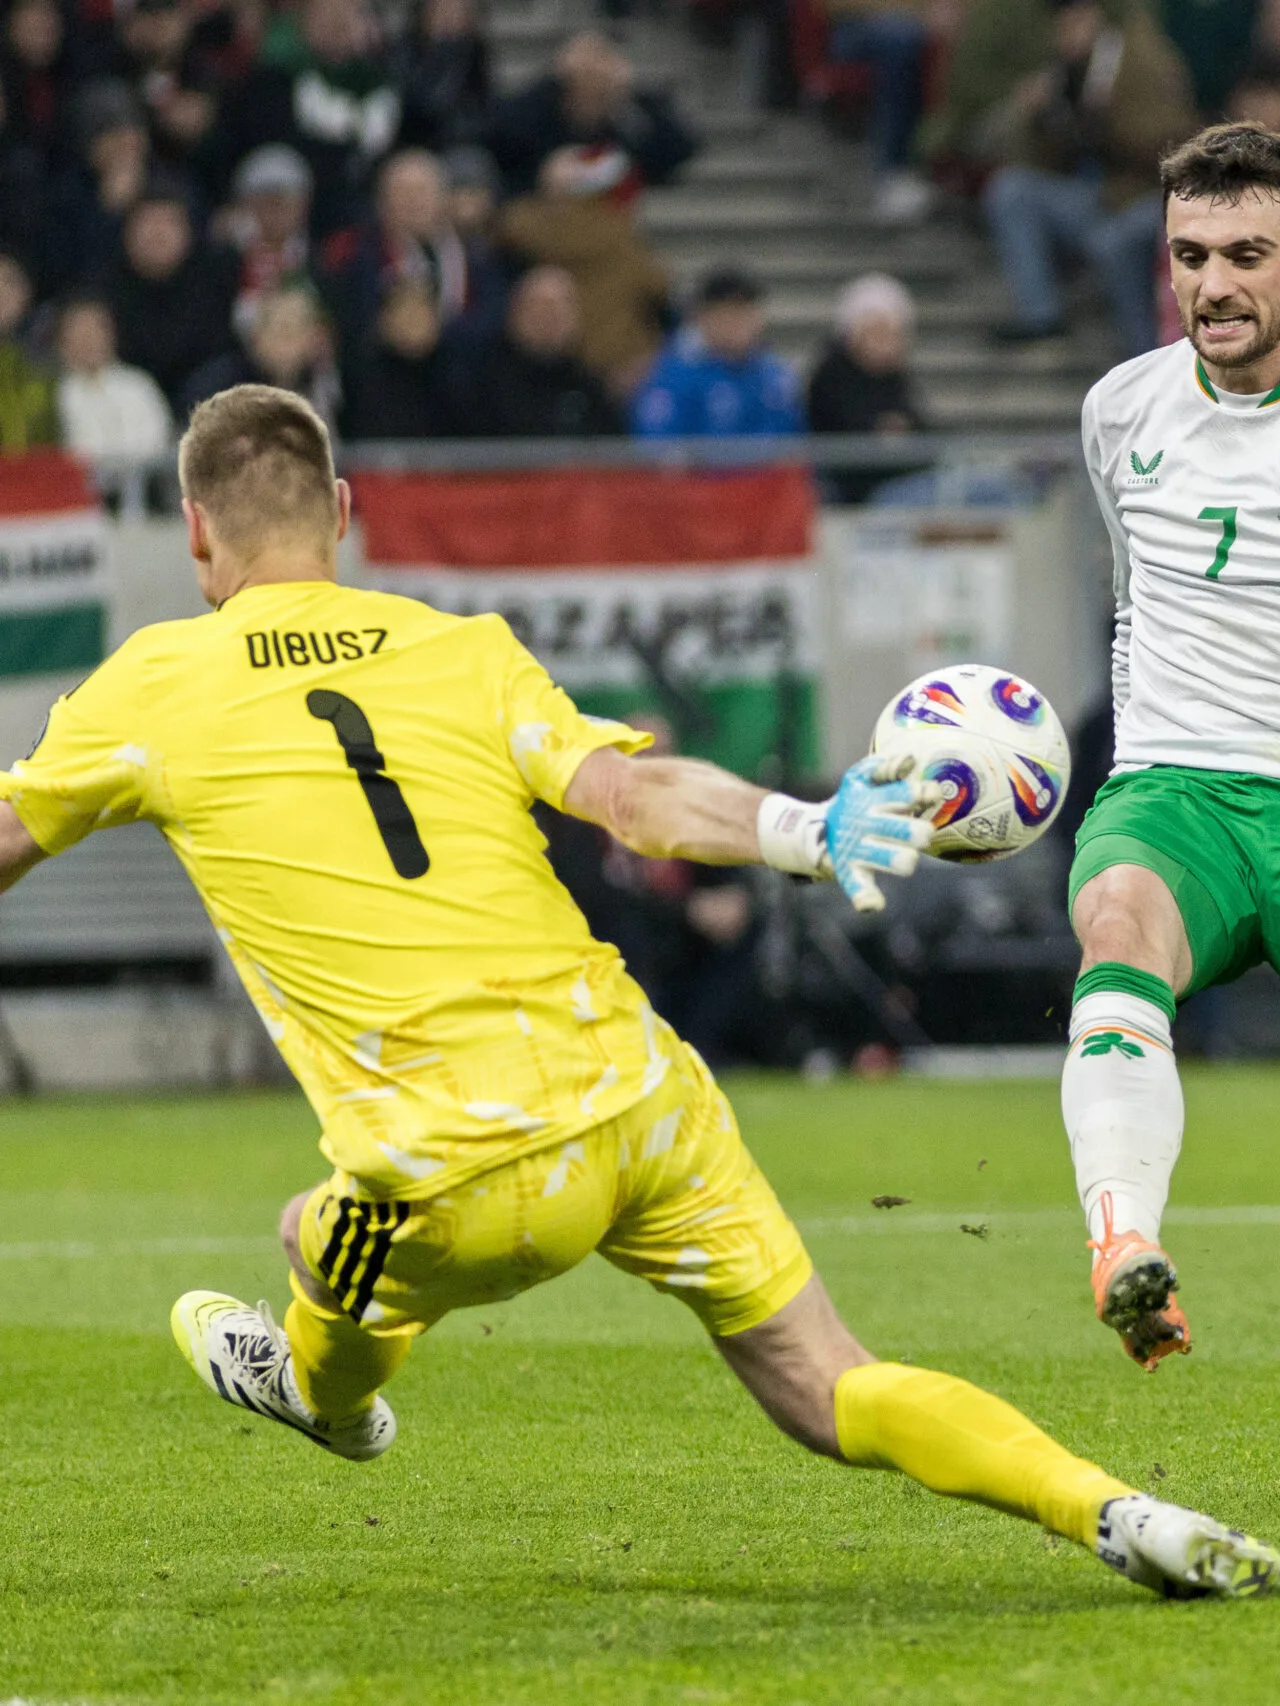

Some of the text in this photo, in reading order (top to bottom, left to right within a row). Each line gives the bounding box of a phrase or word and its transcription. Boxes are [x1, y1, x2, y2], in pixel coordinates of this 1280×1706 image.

[1197, 506, 1238, 579] 7
[245, 628, 393, 669] DIBUSZ
[305, 688, 430, 880] 1
